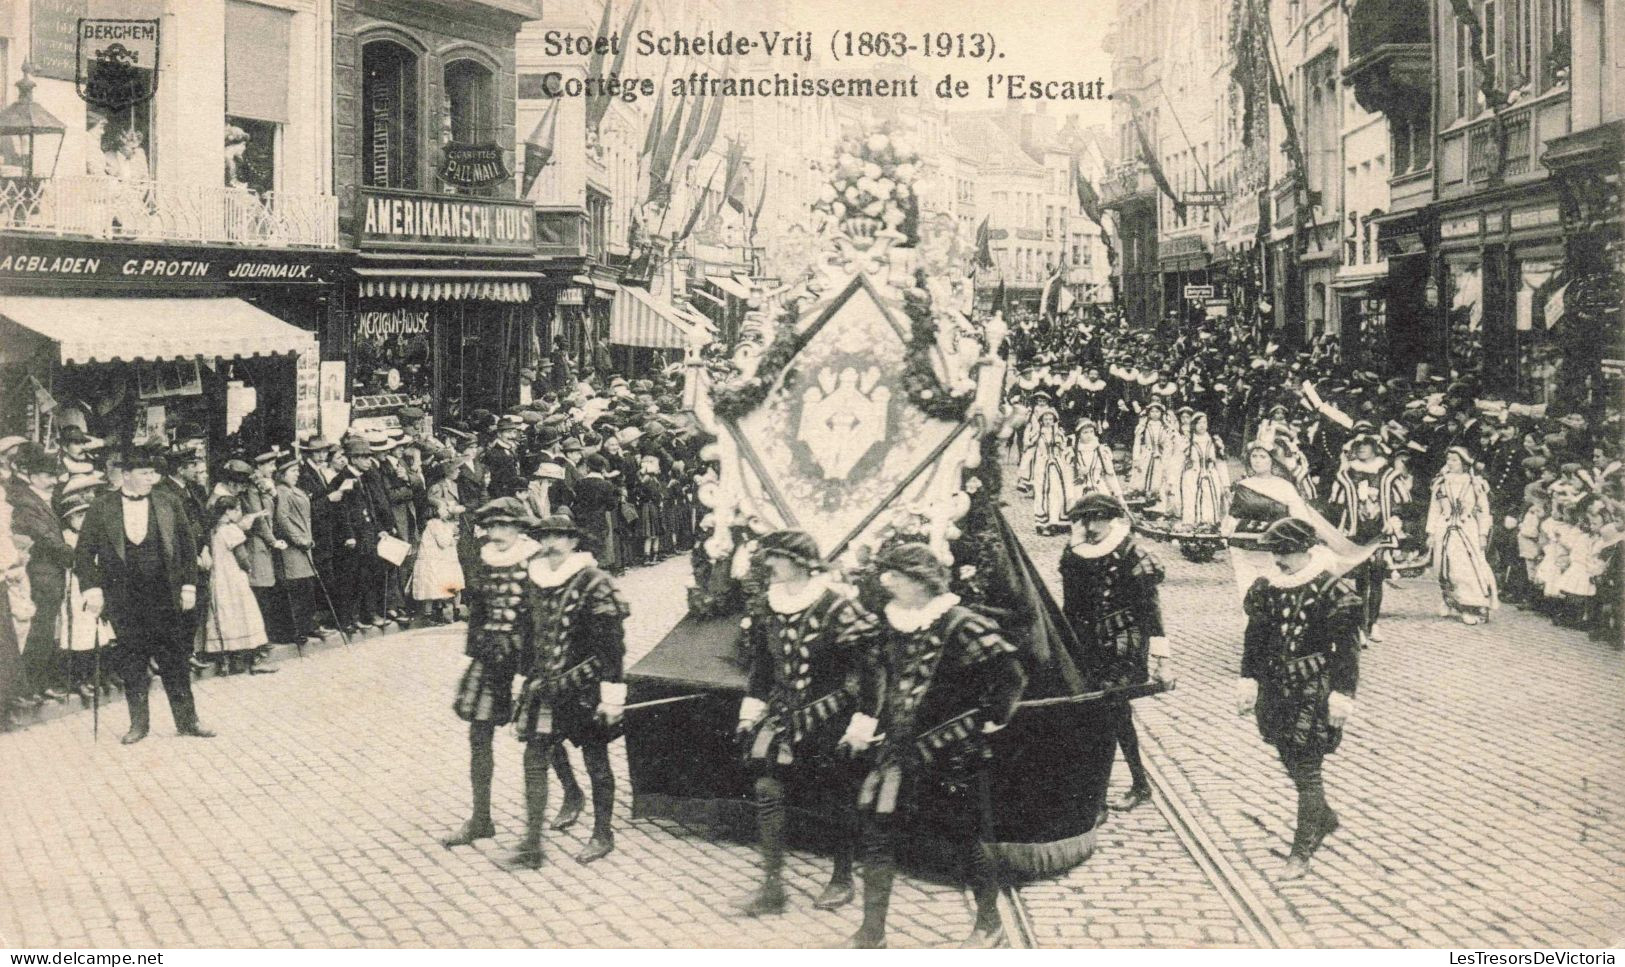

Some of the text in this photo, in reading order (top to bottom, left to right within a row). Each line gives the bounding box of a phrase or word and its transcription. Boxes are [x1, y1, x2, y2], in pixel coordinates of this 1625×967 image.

[365, 197, 530, 241] AMERIKAANSCH HUIS
[229, 263, 314, 279] JOURNAUX.
